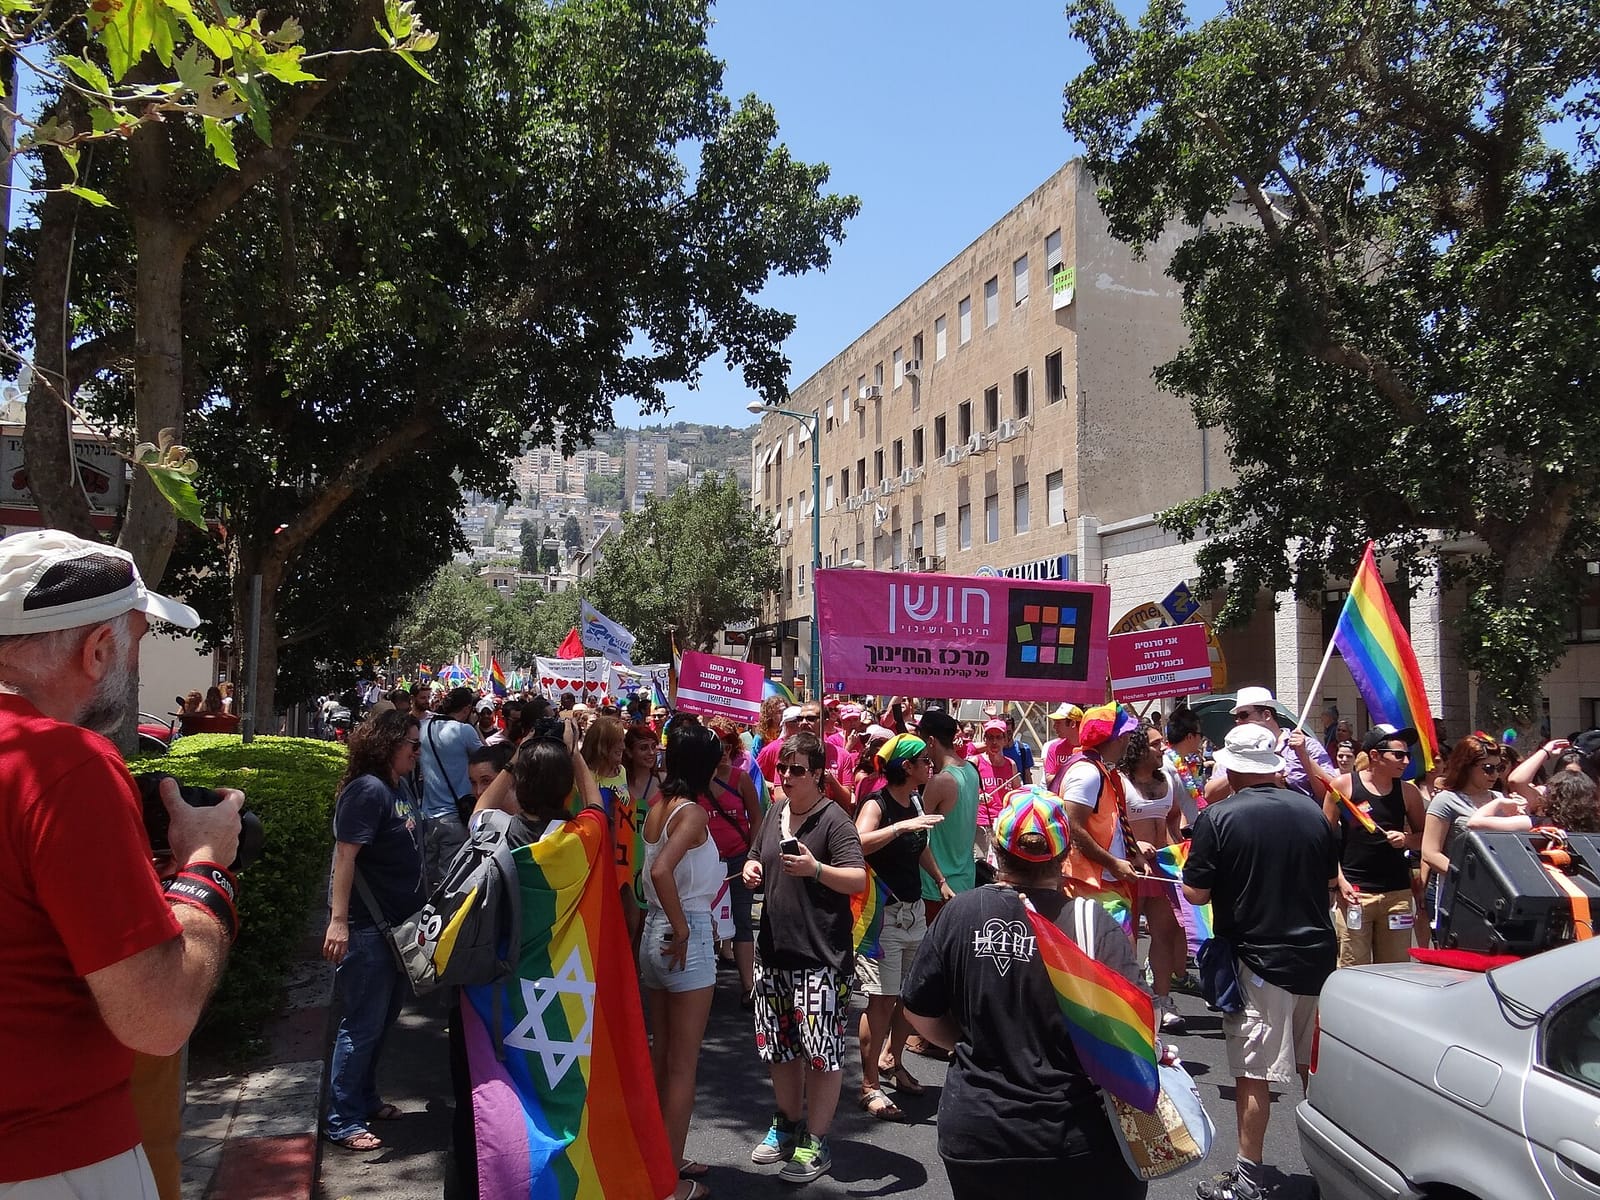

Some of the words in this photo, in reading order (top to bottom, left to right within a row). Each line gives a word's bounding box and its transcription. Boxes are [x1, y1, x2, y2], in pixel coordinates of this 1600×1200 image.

[1002, 557, 1061, 580] КНИГИ
[889, 583, 990, 634] חושן
[901, 625, 943, 634] ושינוי
[953, 627, 989, 637] חינוך
[1165, 637, 1178, 645] אני
[864, 645, 932, 665] החינוך
[939, 648, 990, 666] מרכז
[709, 663, 724, 672] הומו
[725, 667, 737, 675] אני
[865, 664, 902, 674] בישראל
[700, 671, 721, 681] שמונה
[943, 667, 972, 679] קהילת
[975, 669, 989, 678] של
[722, 676, 744, 686] מקרית
[170, 882, 196, 896] Mark
[195, 888, 209, 899] III
